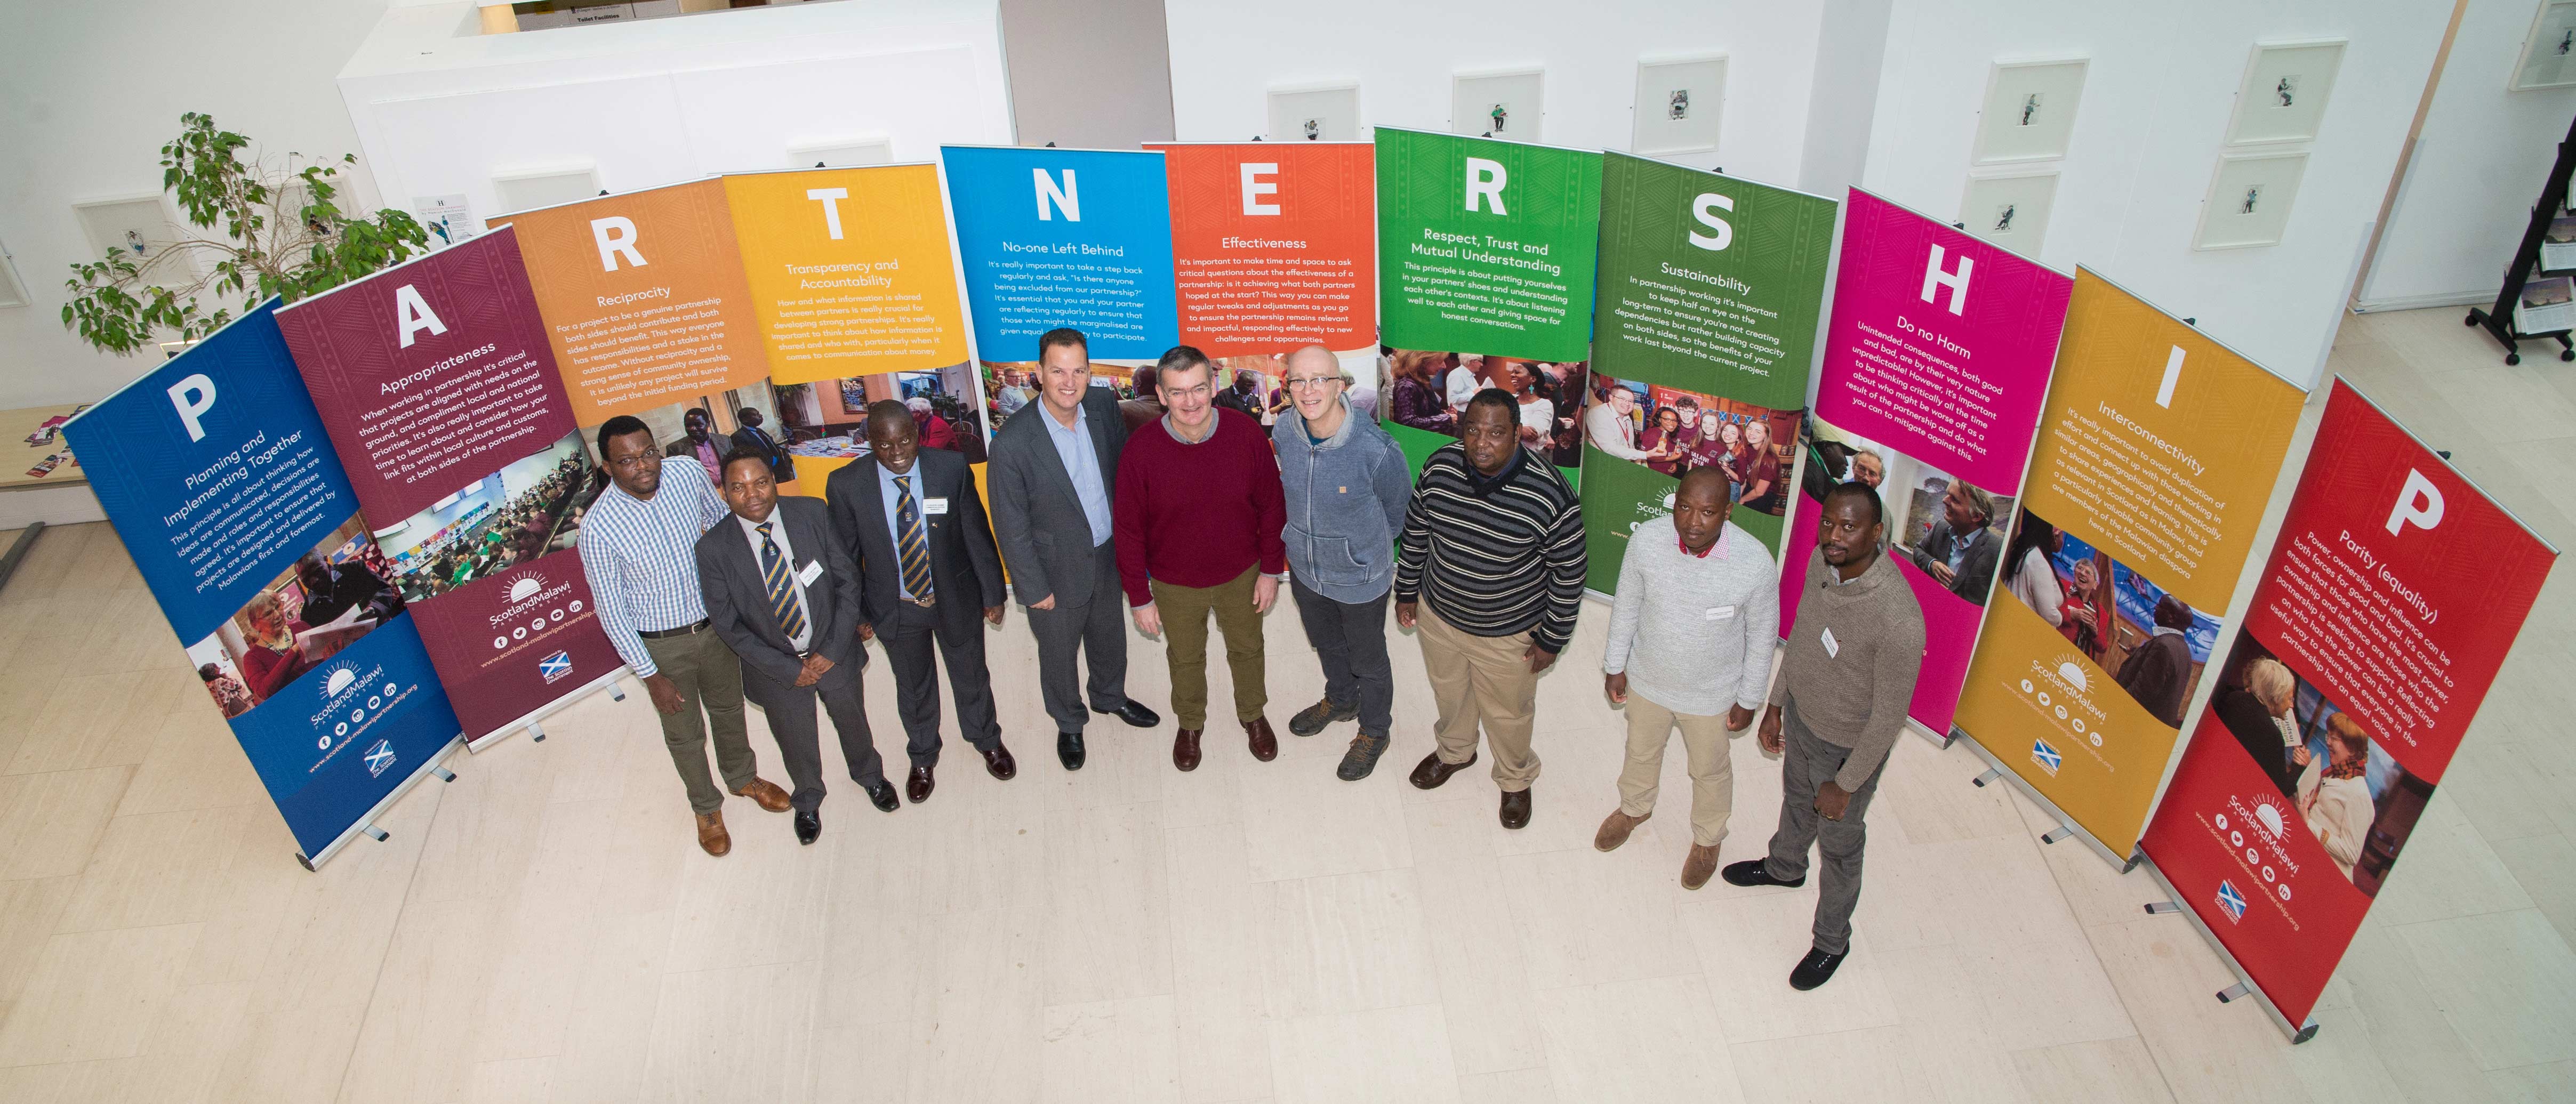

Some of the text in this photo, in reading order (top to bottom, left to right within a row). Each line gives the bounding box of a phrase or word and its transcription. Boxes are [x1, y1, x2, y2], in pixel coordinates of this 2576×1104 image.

[1033, 168, 1080, 221] N
[1240, 163, 1280, 215] E
[1466, 157, 1507, 215] R
[807, 188, 848, 239] T
[1689, 194, 1733, 251] S
[590, 216, 648, 272] R
[784, 257, 900, 275] Transparency and
[1001, 260, 1024, 270] really
[1104, 265, 1122, 275] step
[1123, 265, 1143, 274] back
[1002, 241, 1124, 257] No-one Left Behind
[1192, 258, 1231, 267] important
[1222, 236, 1307, 249] Effectiveness
[1411, 242, 1561, 277] Mutual Understanding
[1424, 228, 1549, 256] Respect, Trust and
[596, 286, 671, 308] Reciprocity
[797, 297, 814, 305] and
[837, 294, 884, 303] information
[800, 275, 892, 290] Accountability
[1403, 261, 1567, 292] This principle is about putting yourselves
[1630, 275, 1778, 319] In partnership working it's important
[1660, 262, 1752, 296] Sustainability
[1921, 244, 1973, 316] H
[396, 284, 447, 349] A
[556, 325, 570, 333] For
[579, 316, 609, 331] project
[640, 305, 673, 318] genuine
[674, 297, 722, 312] partnership
[1659, 293, 1680, 307] keep
[1681, 299, 1698, 310] half
[1712, 309, 1727, 317] eye
[1742, 315, 1756, 325] the
[1857, 320, 2003, 396] Unintended consequences, both good
[1897, 315, 1971, 360] Do no Harm
[360, 407, 388, 422] When
[388, 392, 424, 410] working
[434, 369, 483, 394] partnership
[483, 362, 496, 373] it's
[497, 349, 526, 367] critical
[381, 343, 496, 396] Appropriateness
[1863, 339, 1991, 403] and bad, are by their very nature
[2156, 345, 2186, 409] I
[167, 374, 216, 443] P
[184, 429, 266, 490] Planning and
[2067, 406, 2226, 510] It's really important to avoid duplication of
[2098, 400, 2206, 477] Interconnectivity
[163, 430, 302, 527] Implementing Together
[170, 531, 189, 545] This
[189, 507, 222, 536] principle
[231, 491, 242, 504] all
[242, 478, 266, 497] about
[265, 457, 298, 480] thinking
[296, 446, 313, 460] how
[2386, 468, 2445, 537] P
[489, 581, 571, 625] ScotlandMalawi
[2307, 531, 2451, 666] Power, ownership and influence can be
[2339, 529, 2438, 625] Parity (equality)
[311, 664, 383, 726] ScotlandMalawi
[547, 670, 573, 684] Government
[555, 666, 572, 676] Scottish
[2032, 659, 2107, 721] ScotlandMalawi
[2229, 795, 2300, 874] ScotlandMalawi
